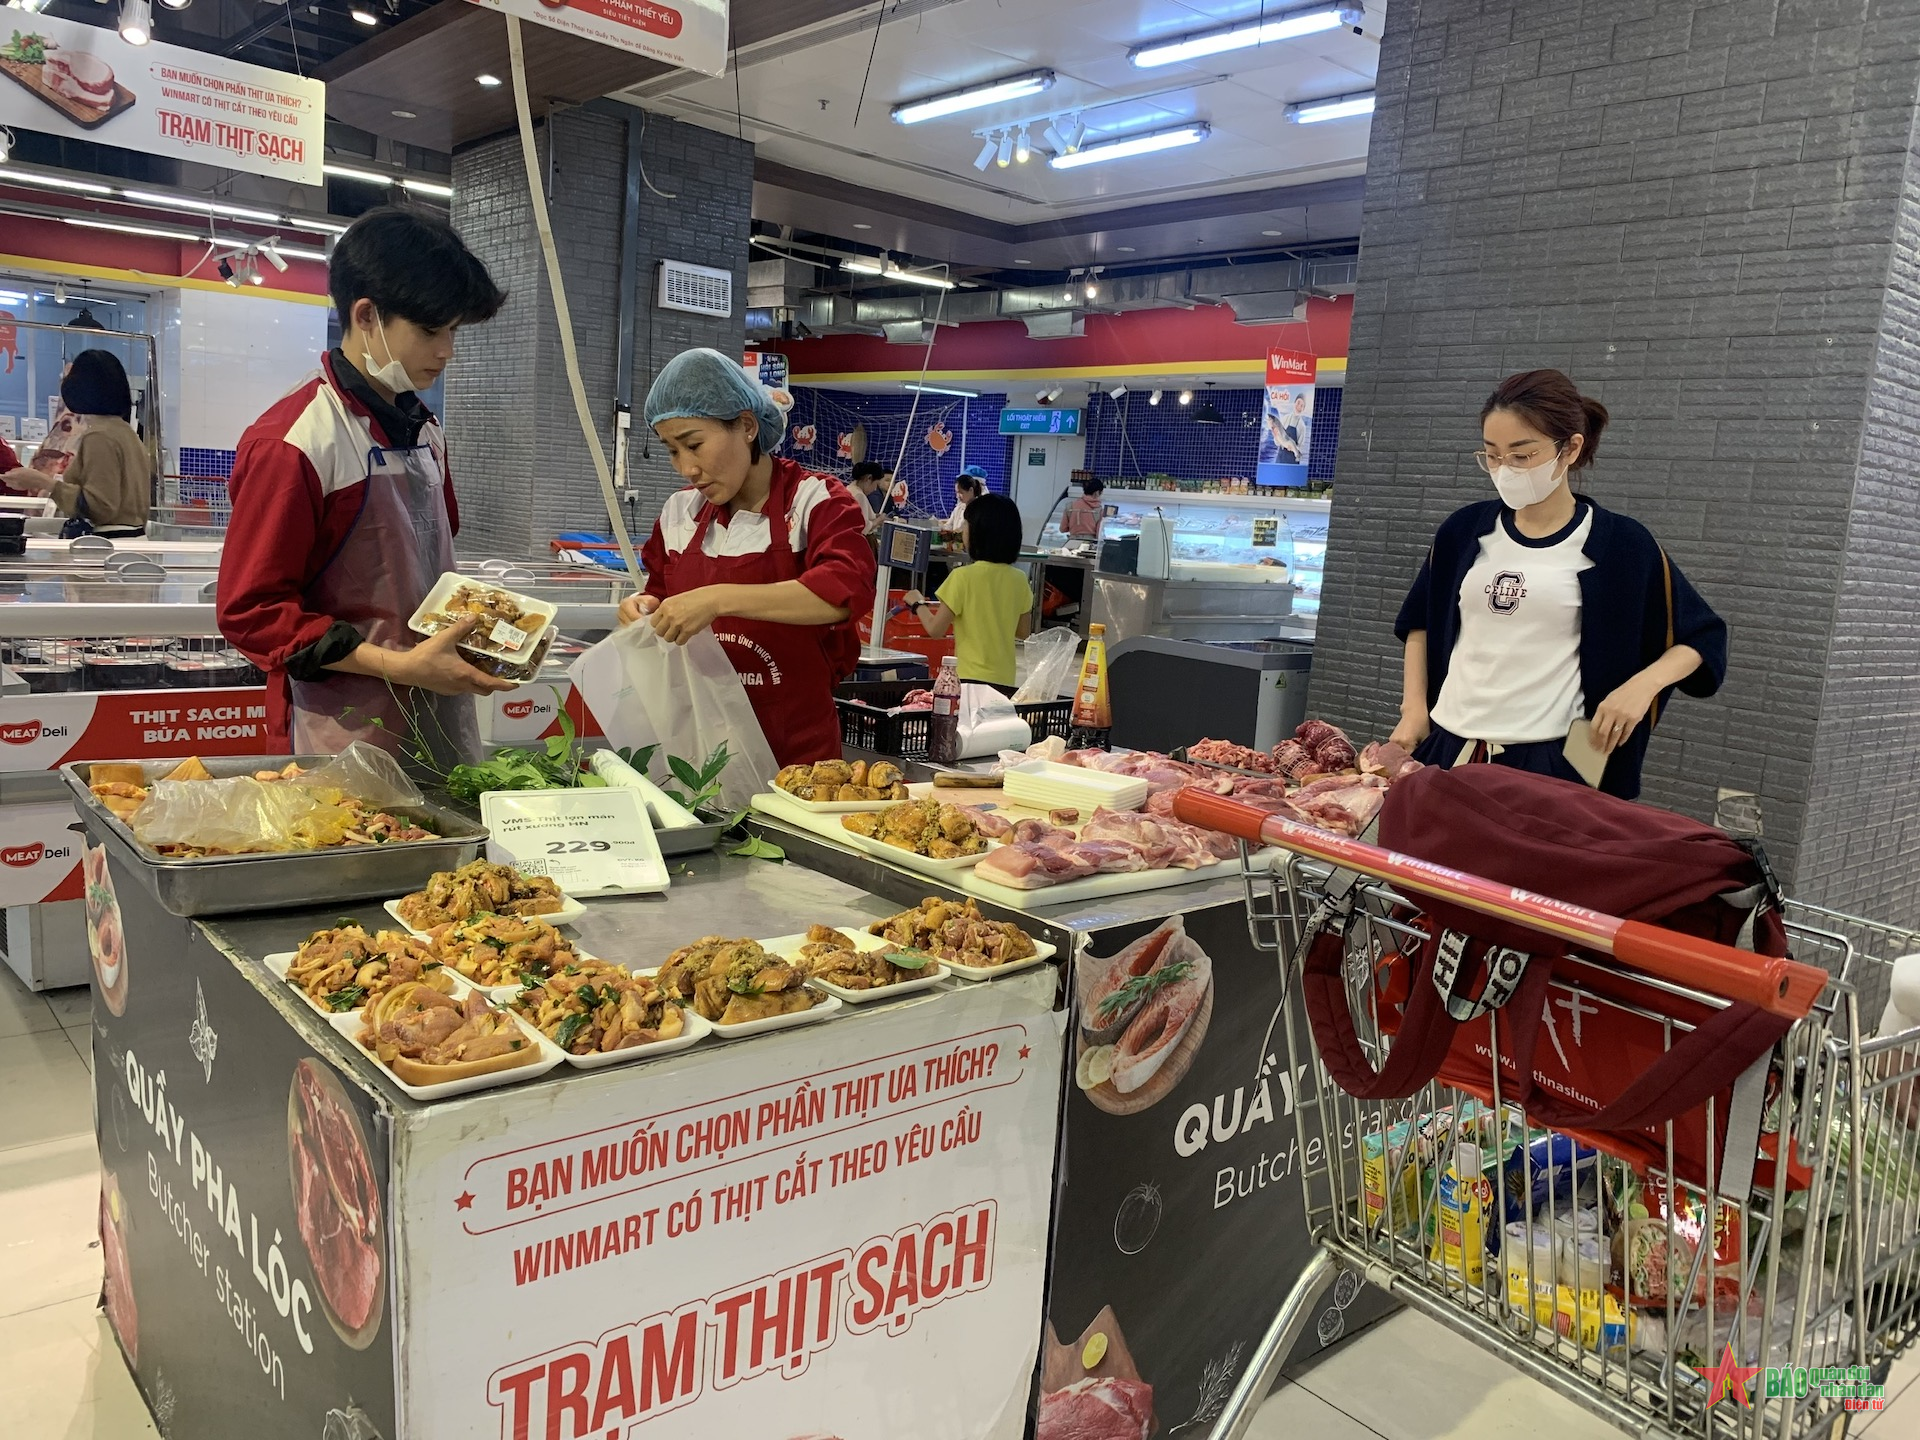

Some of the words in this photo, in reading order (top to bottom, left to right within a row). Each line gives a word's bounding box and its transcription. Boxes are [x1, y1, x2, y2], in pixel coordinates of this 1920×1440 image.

[634, 5, 657, 20] THIẾT
[658, 12, 674, 25] YẾU
[161, 67, 178, 80] BẠN
[179, 72, 202, 85] MUỐN
[203, 78, 224, 92] CHỌN
[247, 88, 264, 102] THỊT
[276, 94, 301, 108] THÍCH?
[162, 87, 200, 104] WINMART
[202, 94, 212, 106] CÓ
[214, 98, 231, 111] THỊT
[248, 106, 267, 118] THEO
[268, 110, 282, 122] YÊU
[158, 111, 211, 144] TRẠM
[215, 124, 255, 154] THỊT
[258, 133, 302, 162] SẠCH
[770, 370, 786, 378] LONG
[1271, 354, 1307, 371] WinMart
[1484, 584, 1528, 598] CELINE
[1488, 570, 1525, 616] C
[738, 634, 754, 649] ỨNG
[754, 644, 772, 662] THỰC
[738, 672, 763, 686] NGA
[129, 709, 180, 726] THỊT
[186, 707, 240, 724] SẠCH
[507, 706, 530, 714] MEAT
[534, 705, 551, 713] Deli
[3, 728, 38, 739] MEAT
[42, 726, 68, 737] Deli
[144, 725, 190, 743] BỮA
[197, 724, 257, 740] NGON
[525, 822, 564, 830] xương
[1282, 821, 1346, 846] WinMart
[6, 851, 40, 862] MEAT
[45, 847, 70, 859] Deli
[546, 840, 611, 854] 229
[1388, 852, 1462, 880] WinMart
[1510, 887, 1596, 919] WinMart
[1174, 1053, 1307, 1158] QUẦY
[506, 1153, 574, 1216] BẠN
[580, 1121, 667, 1192] MUỐN
[675, 1111, 749, 1170] CHỌN
[757, 1079, 826, 1140] PHẦN
[832, 1072, 882, 1119] THỊT
[887, 1063, 919, 1104] ƯA
[923, 1042, 999, 1098] THÍCH?
[126, 1049, 184, 1166] QUẦY
[190, 1131, 245, 1258] PHA
[251, 1212, 314, 1354] LÓC
[513, 1210, 656, 1287] WINMART
[667, 1195, 703, 1236] CÓ
[710, 1174, 770, 1224] THỊT
[774, 1152, 820, 1202] CẮT
[828, 1146, 889, 1192] THEO
[894, 1121, 937, 1167] YÊU
[940, 1111, 982, 1152] CẦU
[148, 1150, 210, 1278] Butcher
[216, 1264, 284, 1401] station
[499, 1312, 703, 1440] TRẠM
[713, 1258, 848, 1368] THỊT
[853, 1206, 992, 1328] SẠCH
